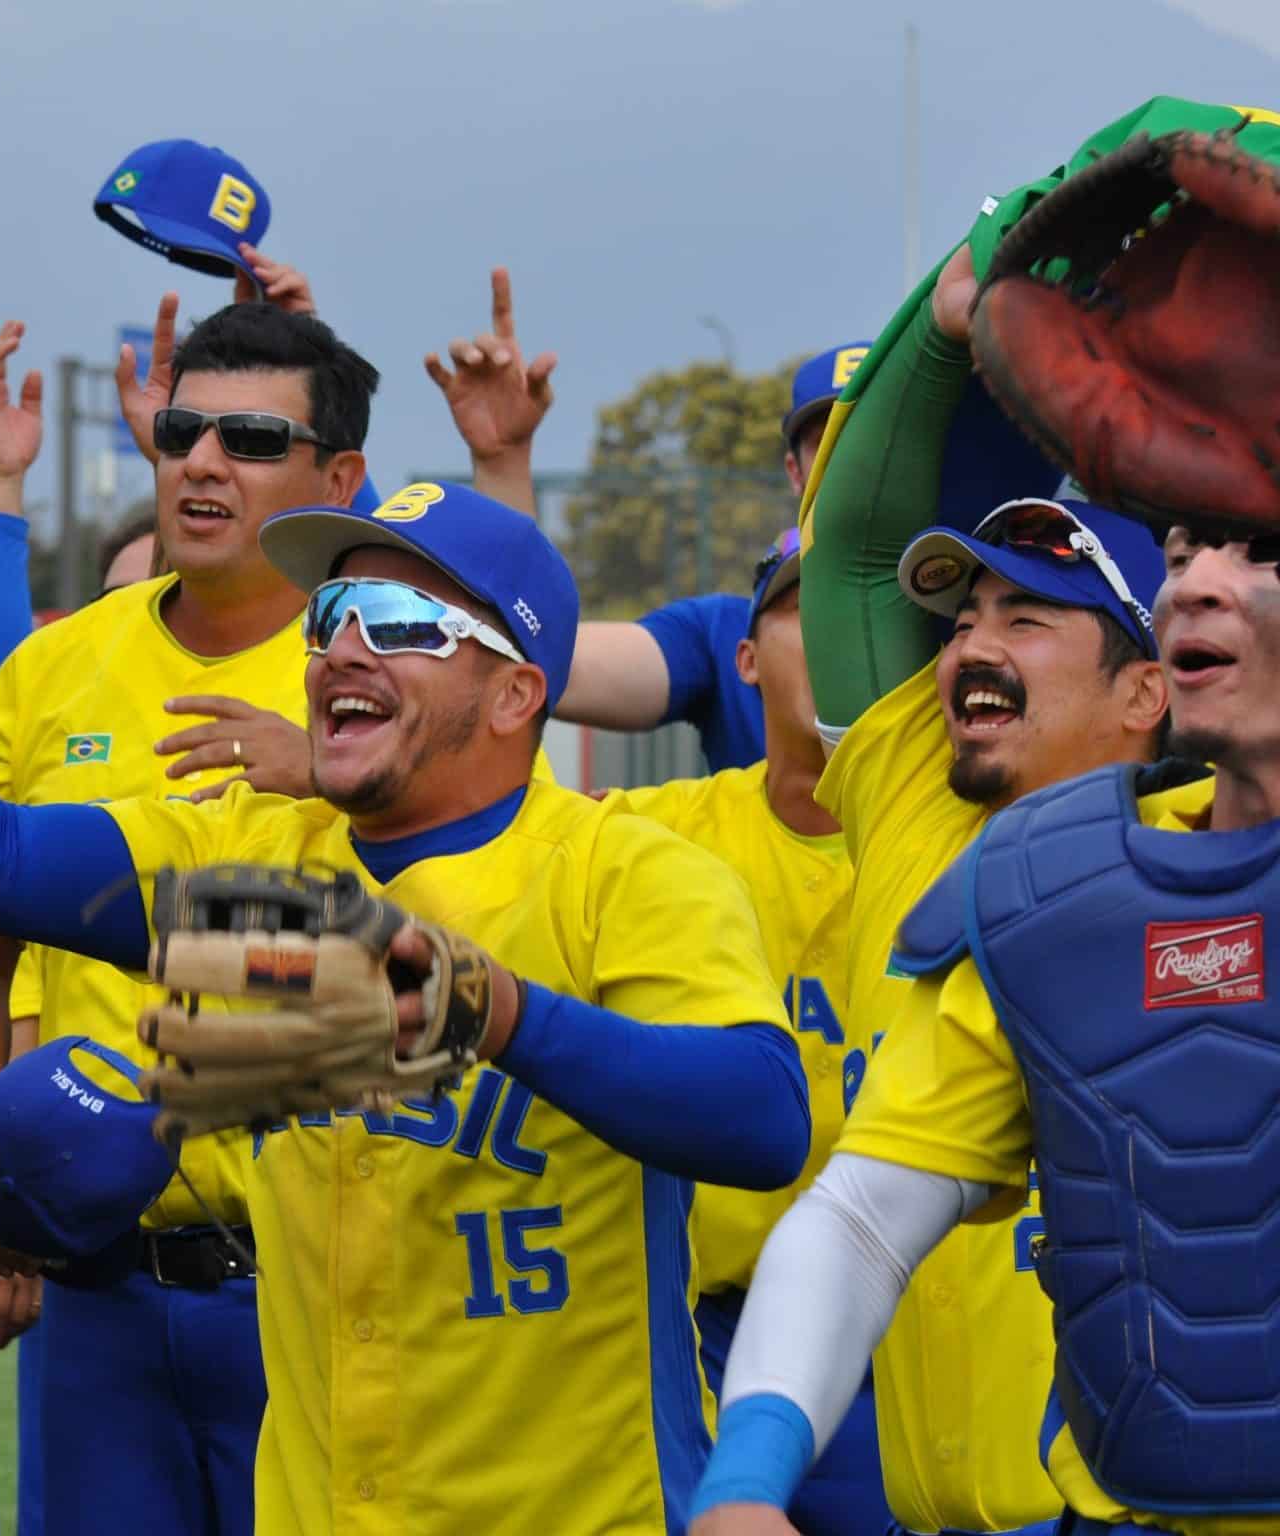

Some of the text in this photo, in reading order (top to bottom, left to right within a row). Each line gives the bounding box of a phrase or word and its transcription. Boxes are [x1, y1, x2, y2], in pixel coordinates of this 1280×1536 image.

[208, 173, 257, 234] B
[371, 482, 446, 523] B
[1155, 938, 1255, 985] Rawlings
[50, 1067, 105, 1115] BRASIL
[454, 1205, 571, 1319] 15
